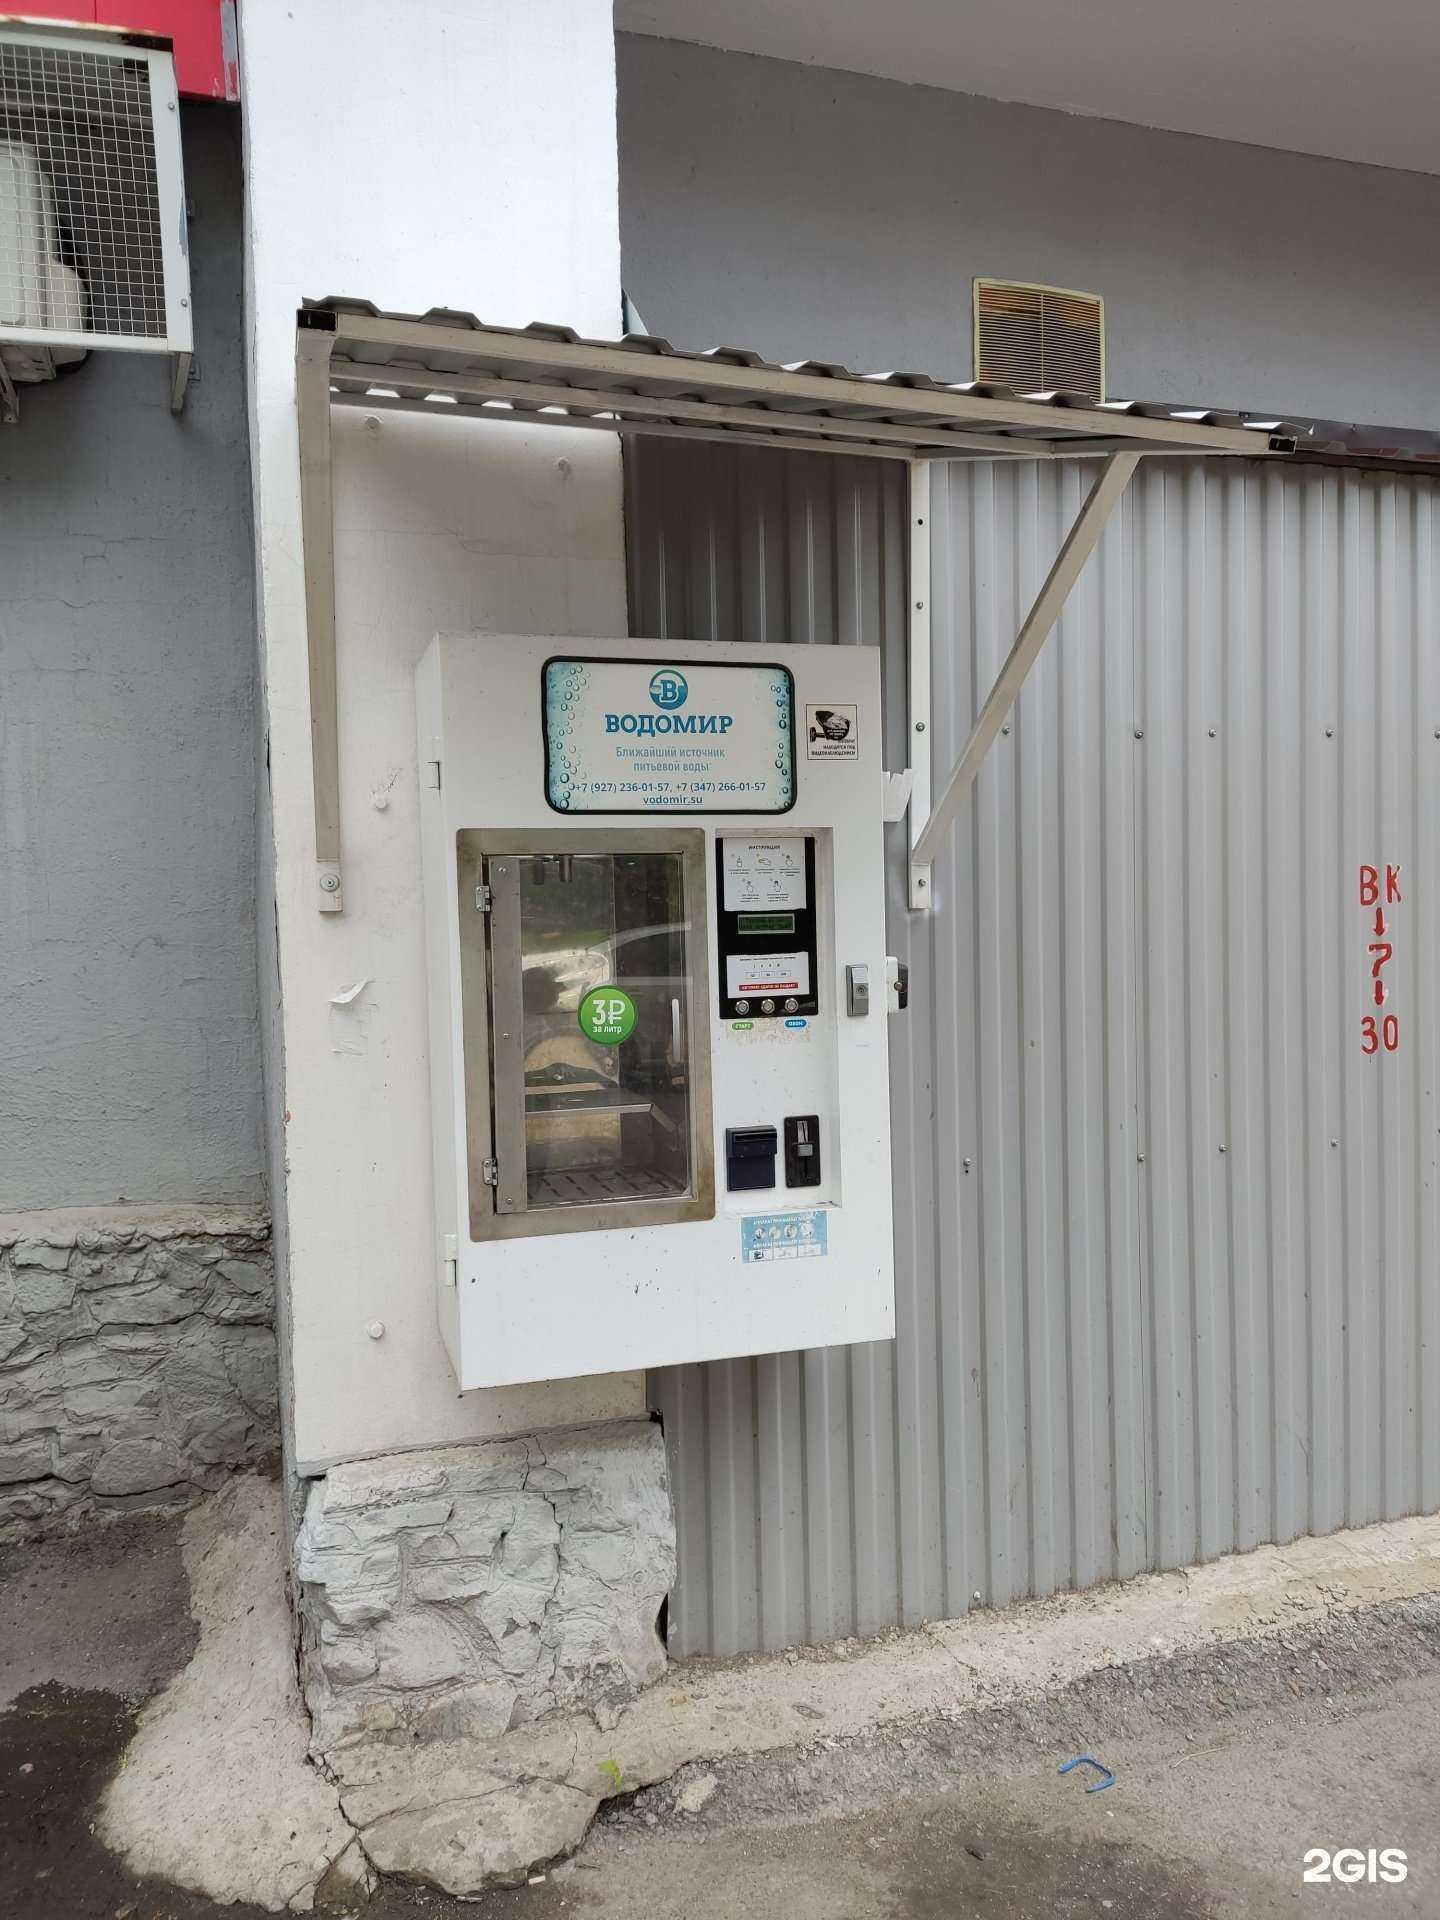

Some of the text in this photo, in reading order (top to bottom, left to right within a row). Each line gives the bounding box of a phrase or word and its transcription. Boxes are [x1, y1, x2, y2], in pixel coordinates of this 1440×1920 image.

[604, 714, 733, 737] ВОДОМИР
[616, 746, 725, 758] Ближайший источник
[633, 761, 709, 773] питьевой воды
[590, 782, 617, 794] (927)
[619, 782, 672, 793] 236-01-57,
[676, 783, 688, 791] +7
[690, 782, 716, 793] (347)
[718, 781, 766, 792] 266-01-57
[643, 795, 704, 805] vodomir.su
[1369, 943, 1393, 978] 7
[592, 1025, 622, 1034] за литр
[1361, 1015, 1399, 1054] 30
